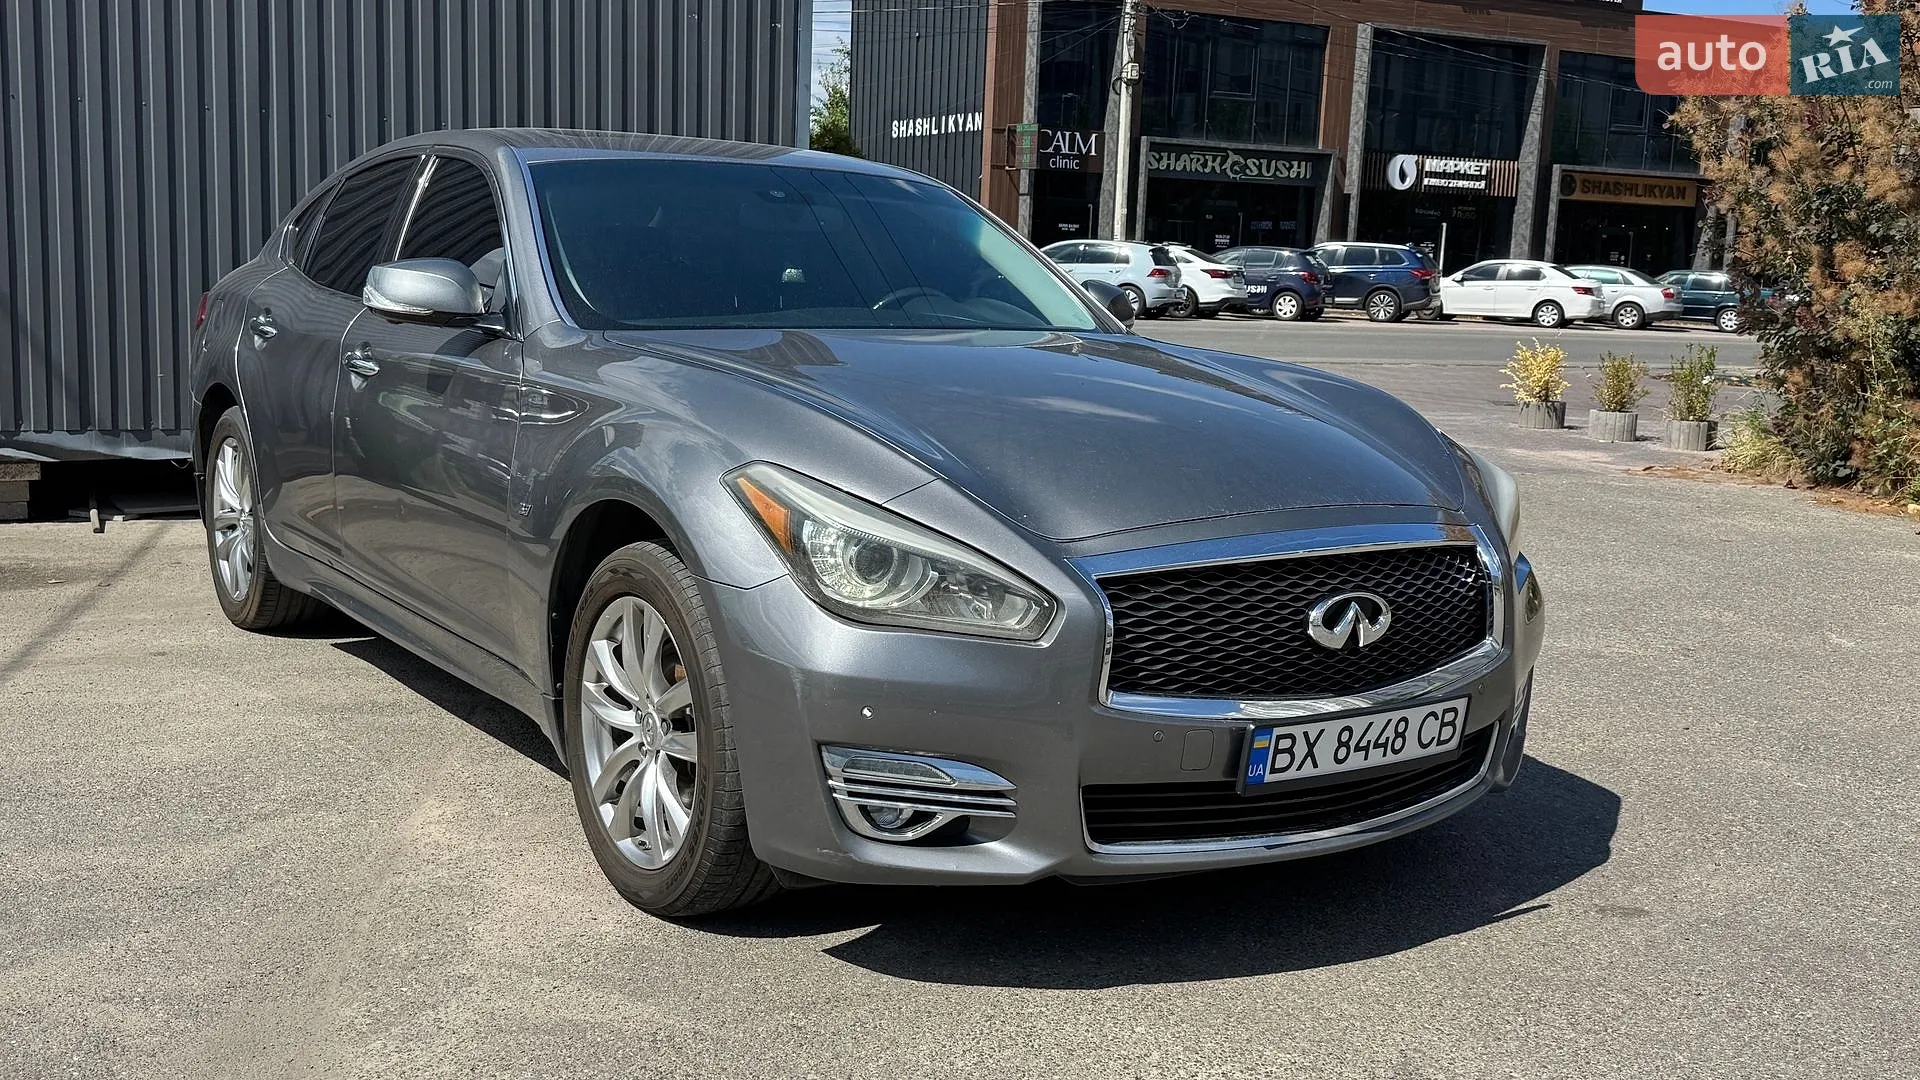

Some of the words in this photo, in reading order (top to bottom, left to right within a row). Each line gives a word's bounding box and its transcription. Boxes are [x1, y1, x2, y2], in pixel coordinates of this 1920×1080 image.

[891, 111, 982, 138] SHASHLIKYAN
[1039, 129, 1098, 156] CALM
[1049, 155, 1080, 169] clinic
[1148, 151, 1223, 174] SHARK
[1245, 158, 1313, 179] SUSHI
[1424, 158, 1490, 175] МАРКЕТ
[1581, 179, 1687, 200] SHASHLIKYAN
[1268, 728, 1325, 775] BX
[1333, 716, 1410, 765] 8448
[1417, 706, 1459, 750] CB
[1248, 764, 1264, 777] UA
